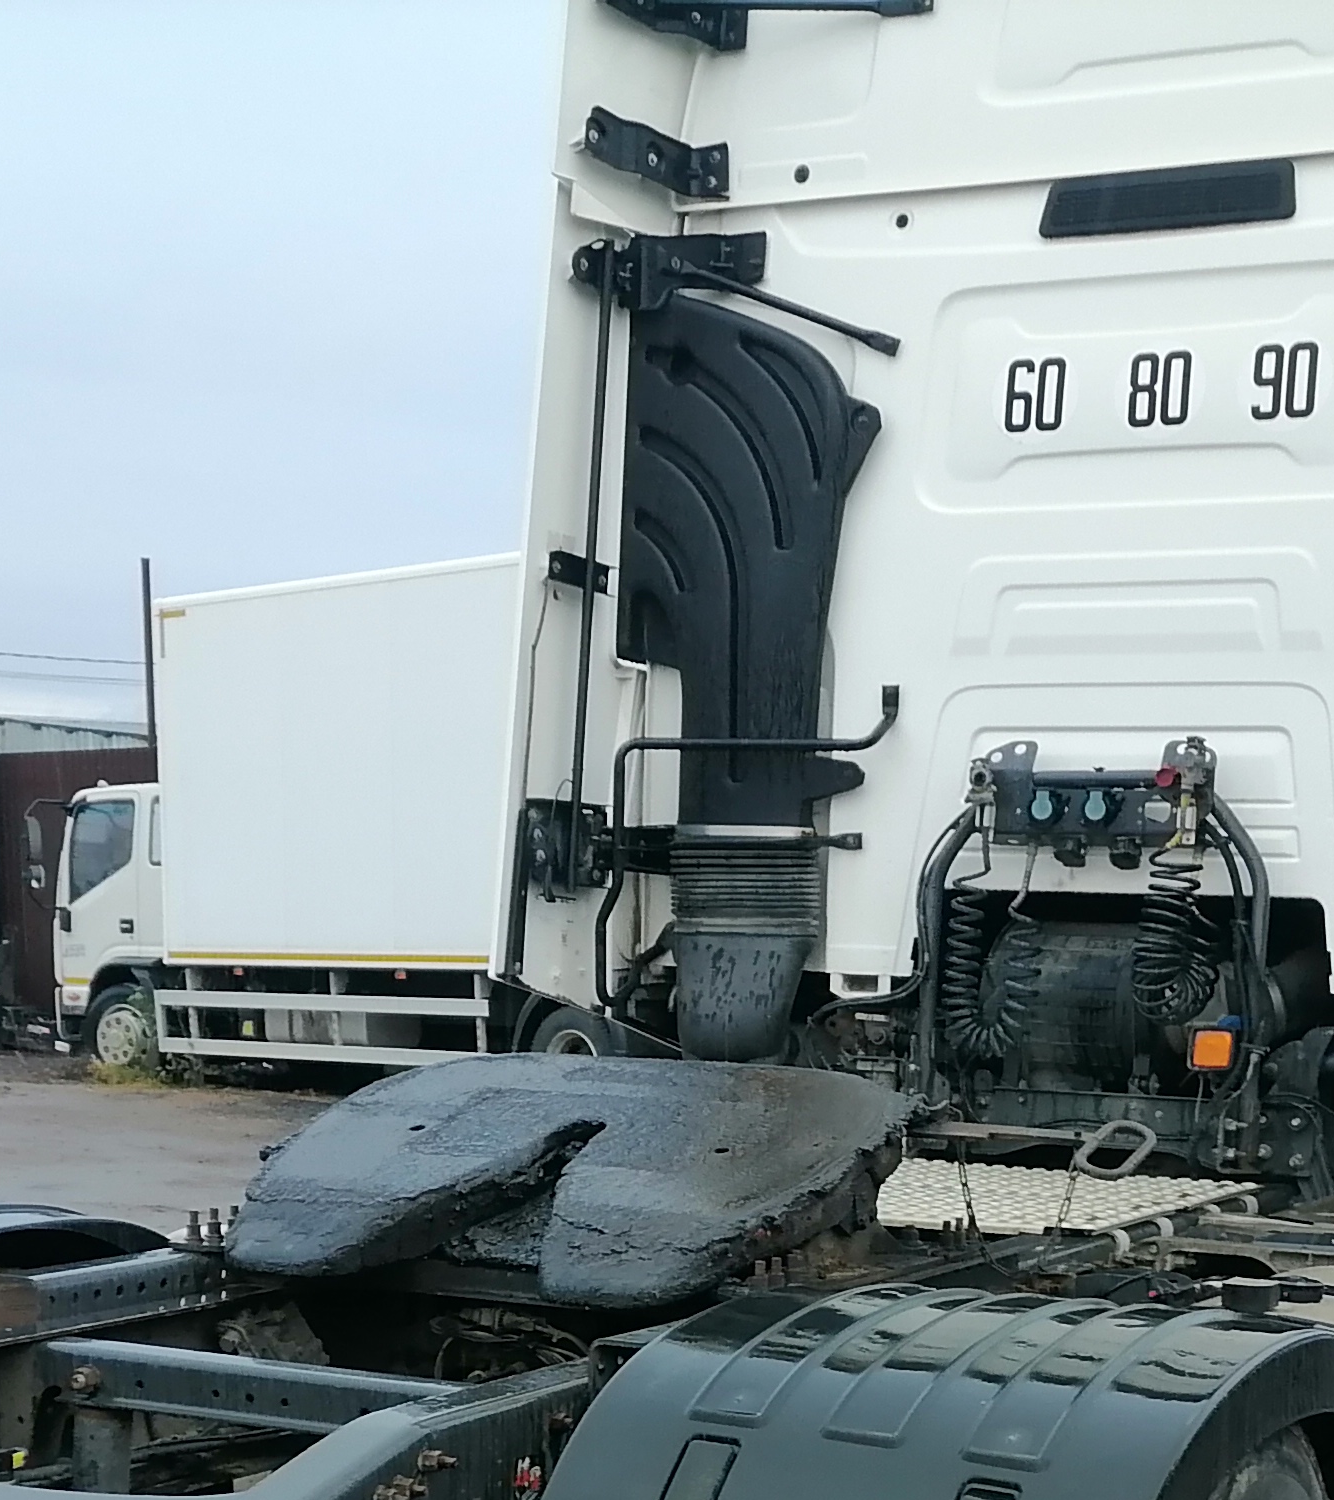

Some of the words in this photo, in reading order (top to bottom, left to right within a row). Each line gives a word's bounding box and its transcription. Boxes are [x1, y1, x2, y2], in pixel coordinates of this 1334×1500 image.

[1004, 357, 1067, 433] 60
[1127, 349, 1193, 428] 80
[1250, 341, 1320, 420] 90
